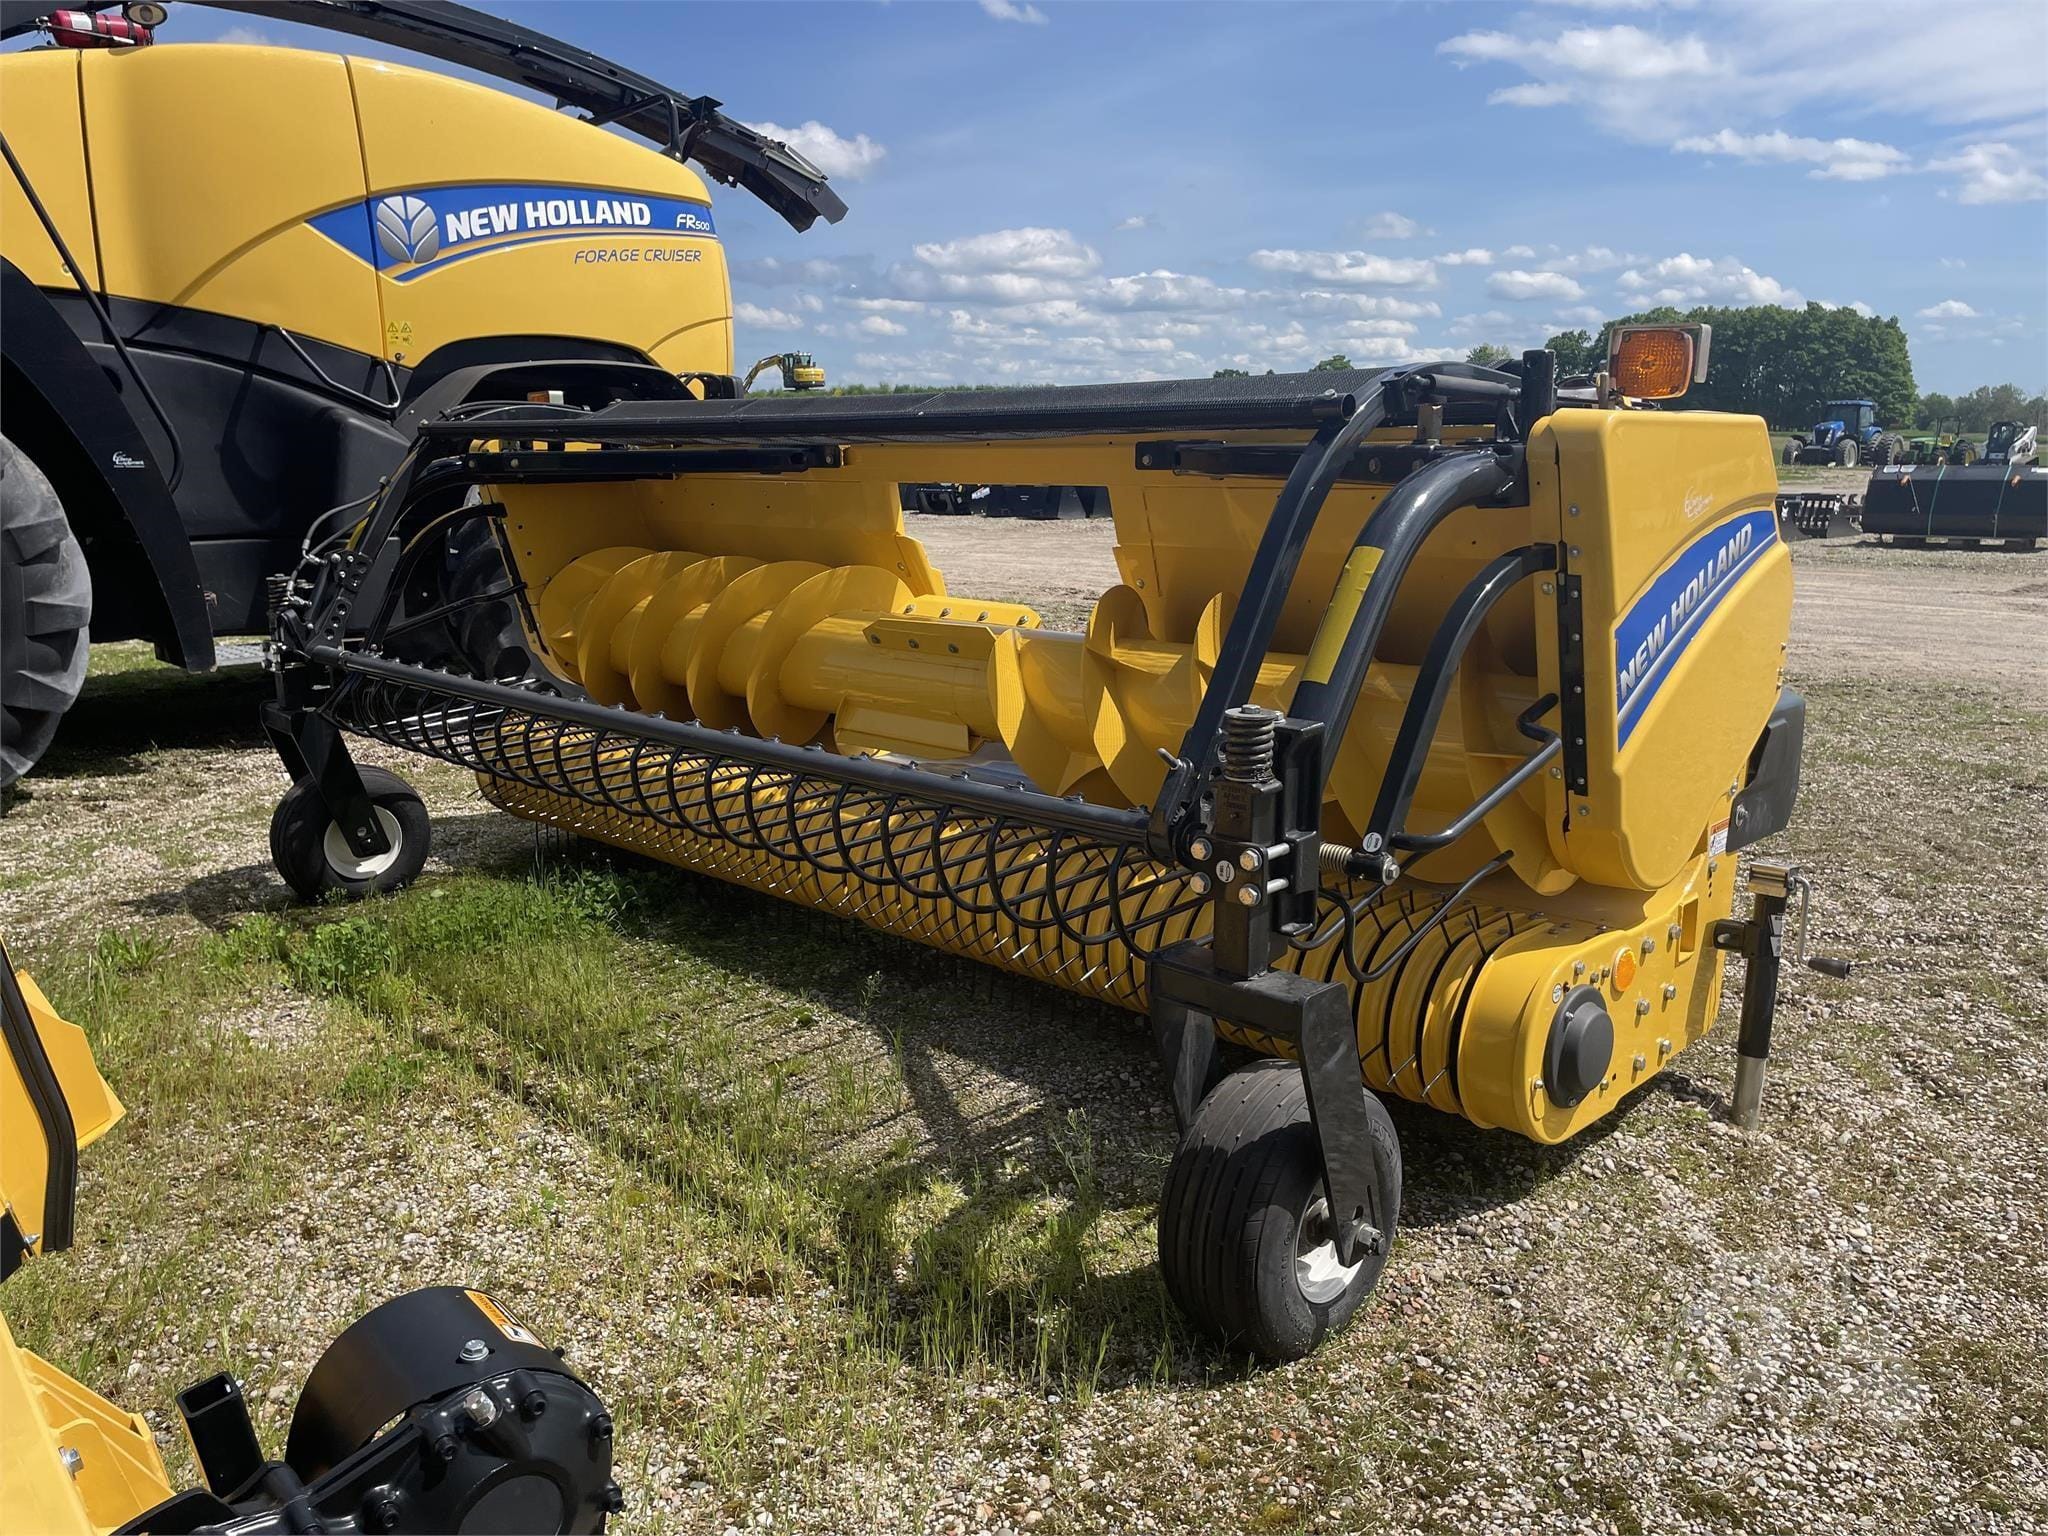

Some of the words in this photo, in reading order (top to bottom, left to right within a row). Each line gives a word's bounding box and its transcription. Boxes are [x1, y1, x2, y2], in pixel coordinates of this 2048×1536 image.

[445, 203, 519, 243] NEW
[524, 199, 651, 228] HOLLAND
[676, 213, 710, 231] FR500
[574, 249, 640, 265] FORAGE
[643, 249, 701, 263] CRUISER
[1620, 613, 1667, 700] NEW
[1671, 522, 1752, 632] HOLLAND
